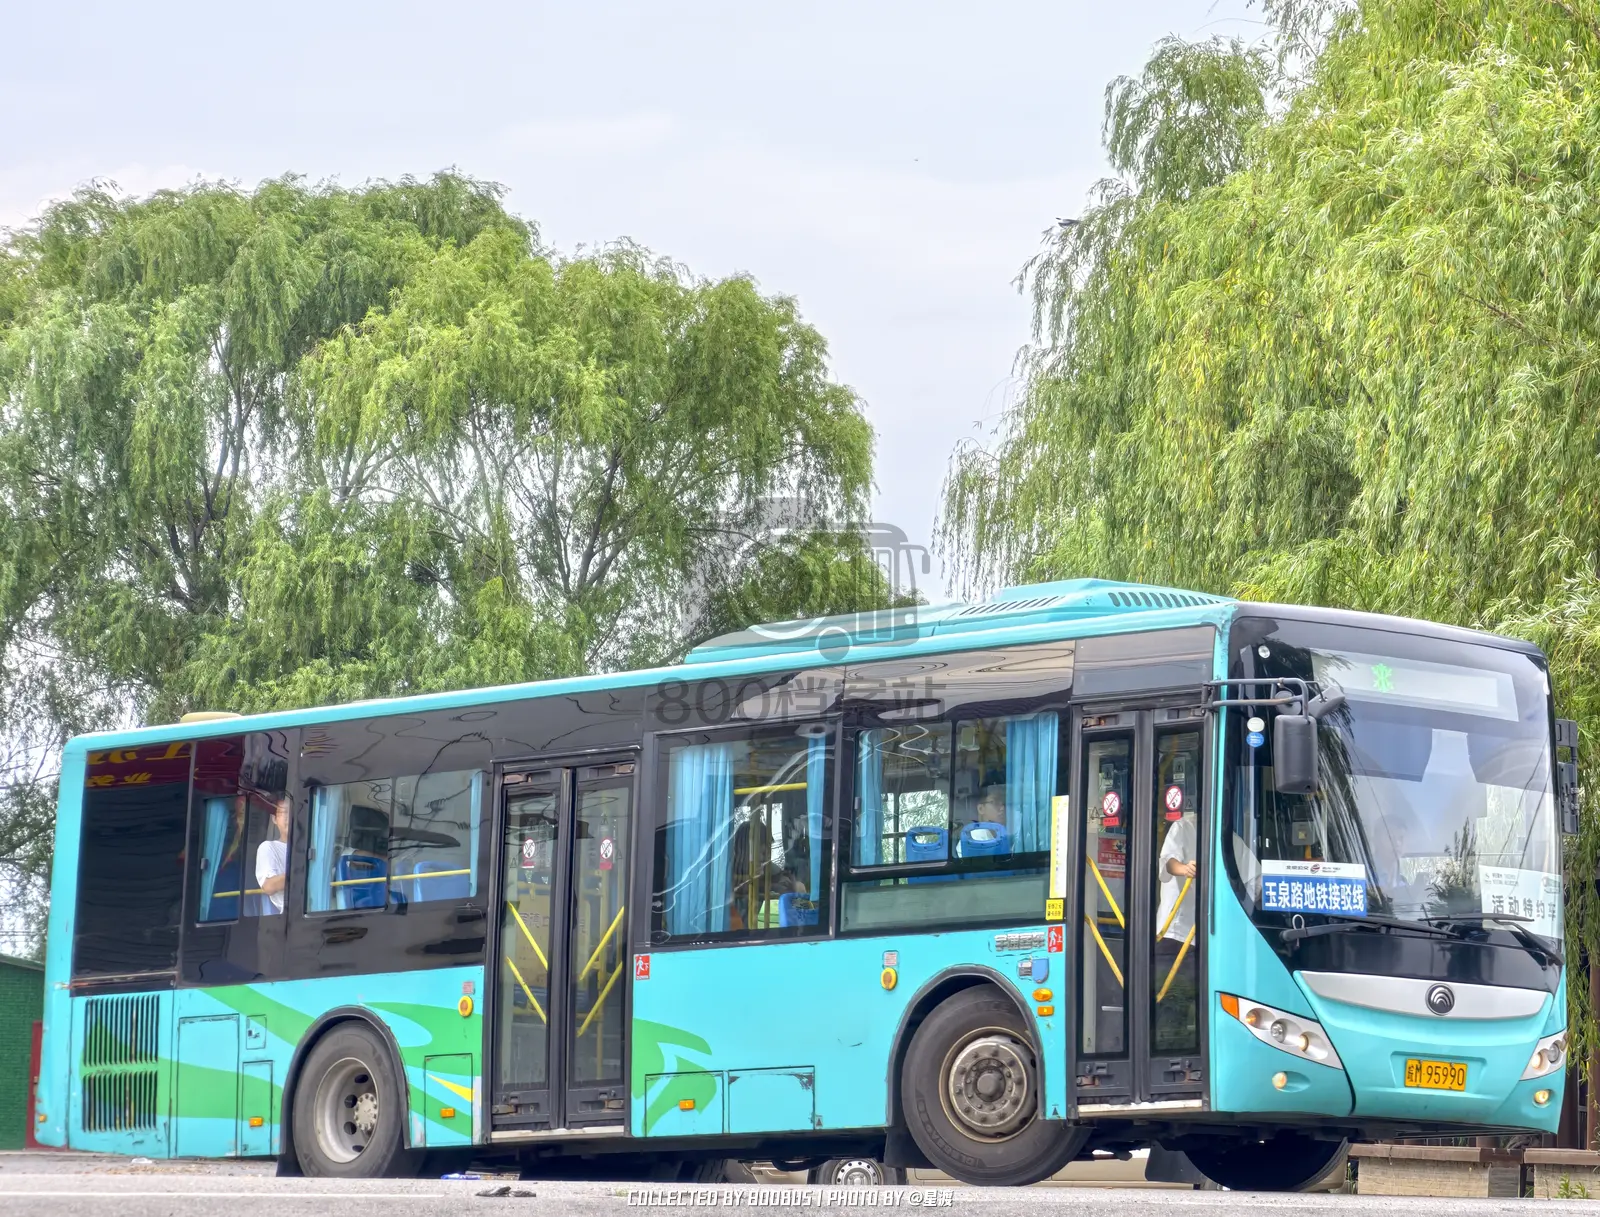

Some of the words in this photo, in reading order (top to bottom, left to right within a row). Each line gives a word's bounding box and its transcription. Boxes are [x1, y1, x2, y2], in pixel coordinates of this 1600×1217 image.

[1264, 881, 1365, 912] 玉泉路地铁接驳线
[1492, 894, 1556, 921] 活动特约车
